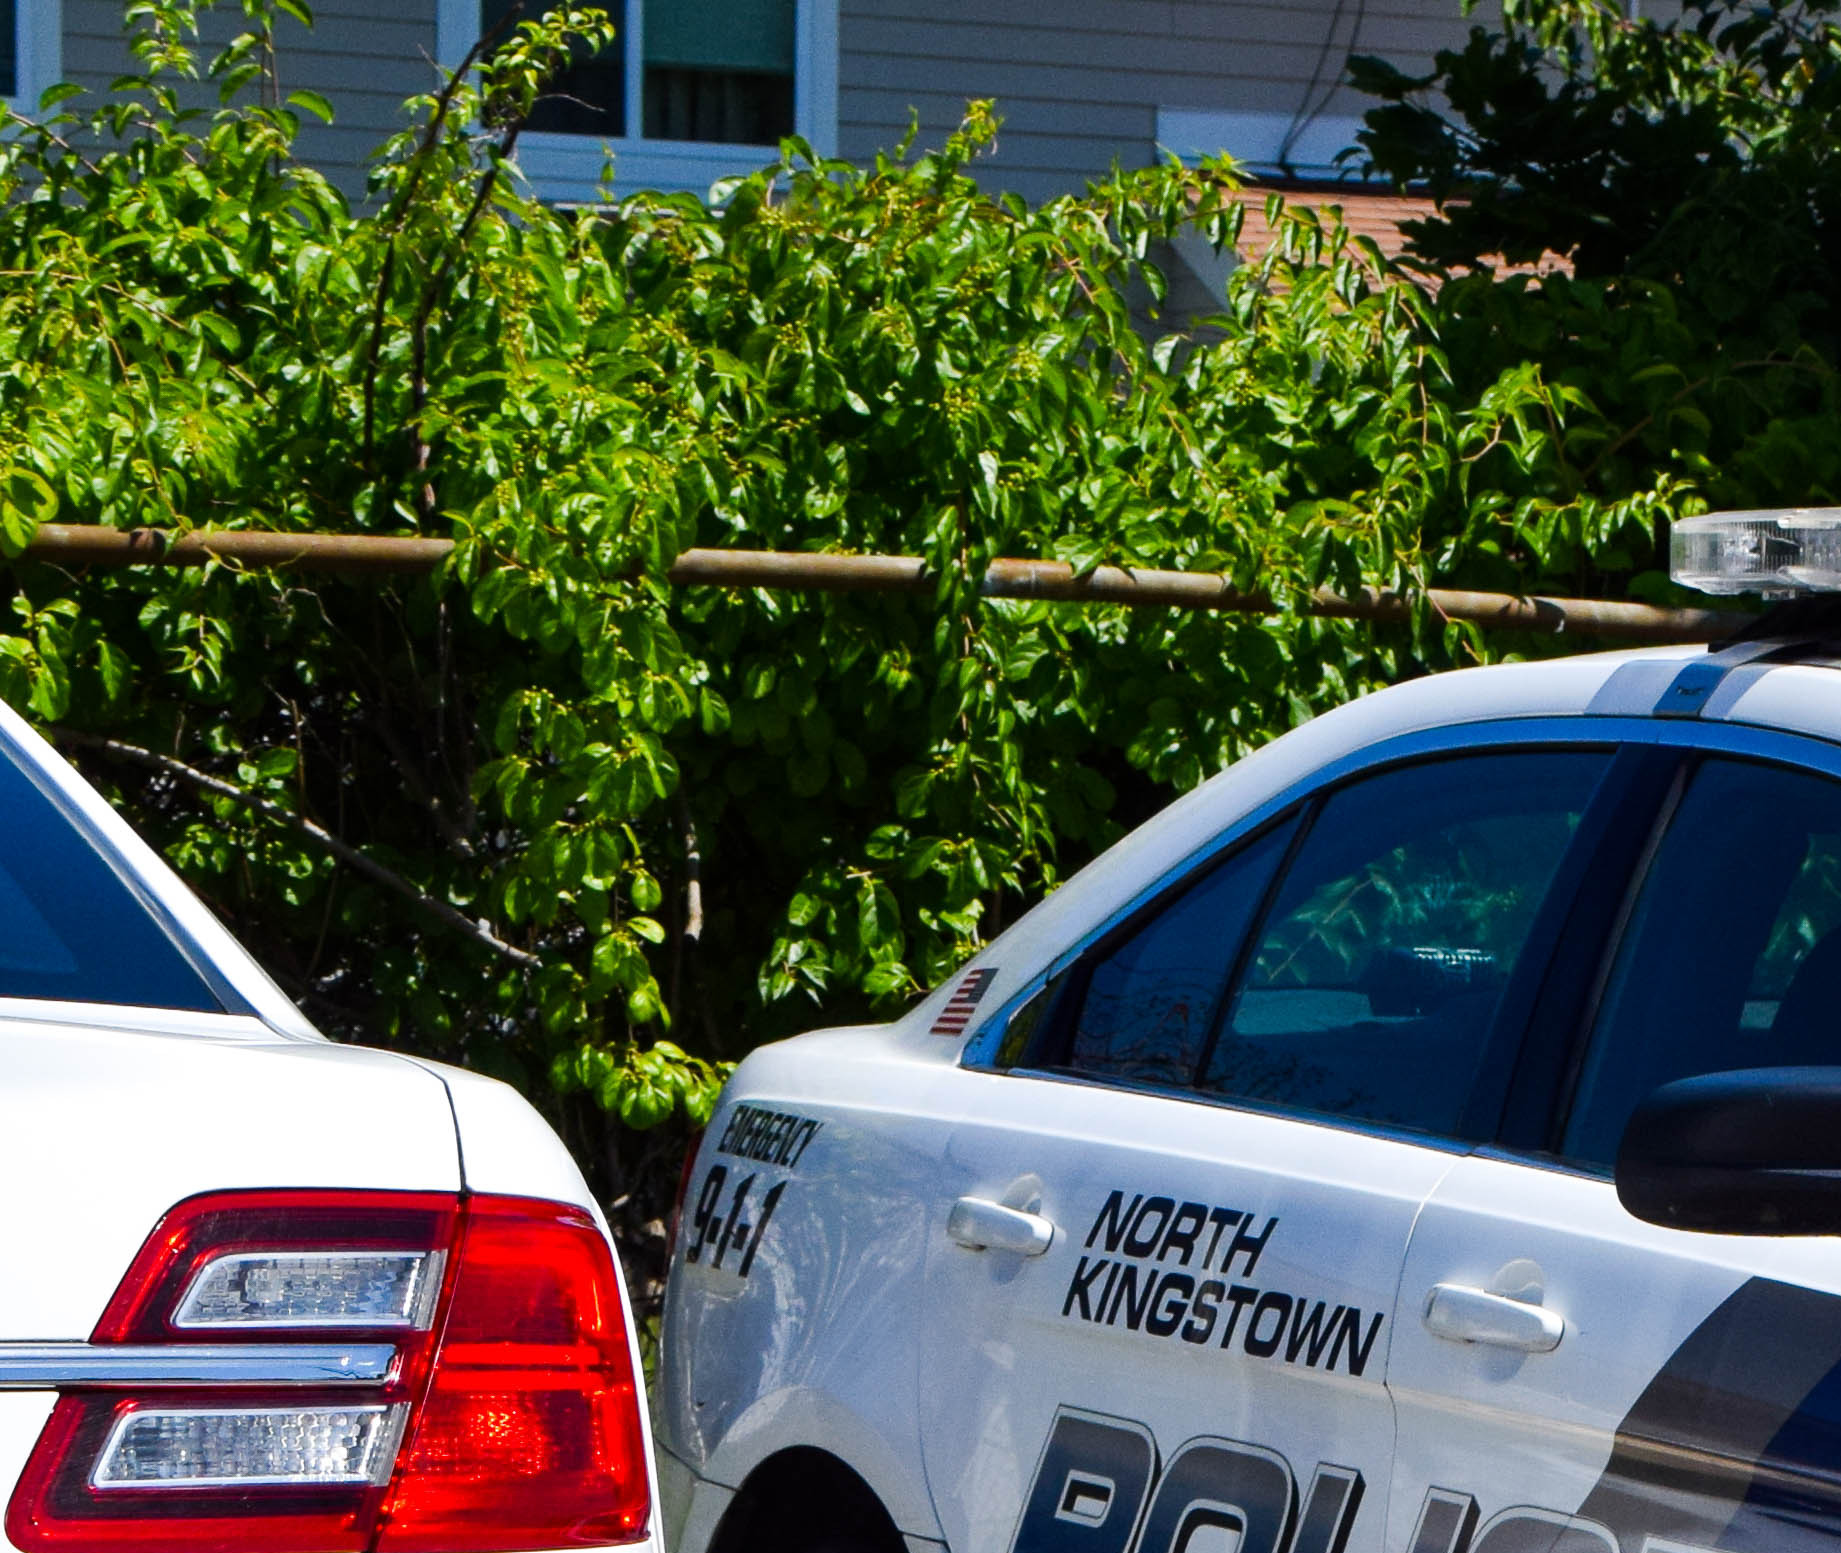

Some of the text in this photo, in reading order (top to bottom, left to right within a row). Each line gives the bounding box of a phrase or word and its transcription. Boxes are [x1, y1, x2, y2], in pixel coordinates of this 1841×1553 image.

[686, 1164, 788, 1278] 9-1-1
[1084, 1189, 1279, 1278] NORTH
[1062, 1256, 1384, 1376] KINGSTOWN
